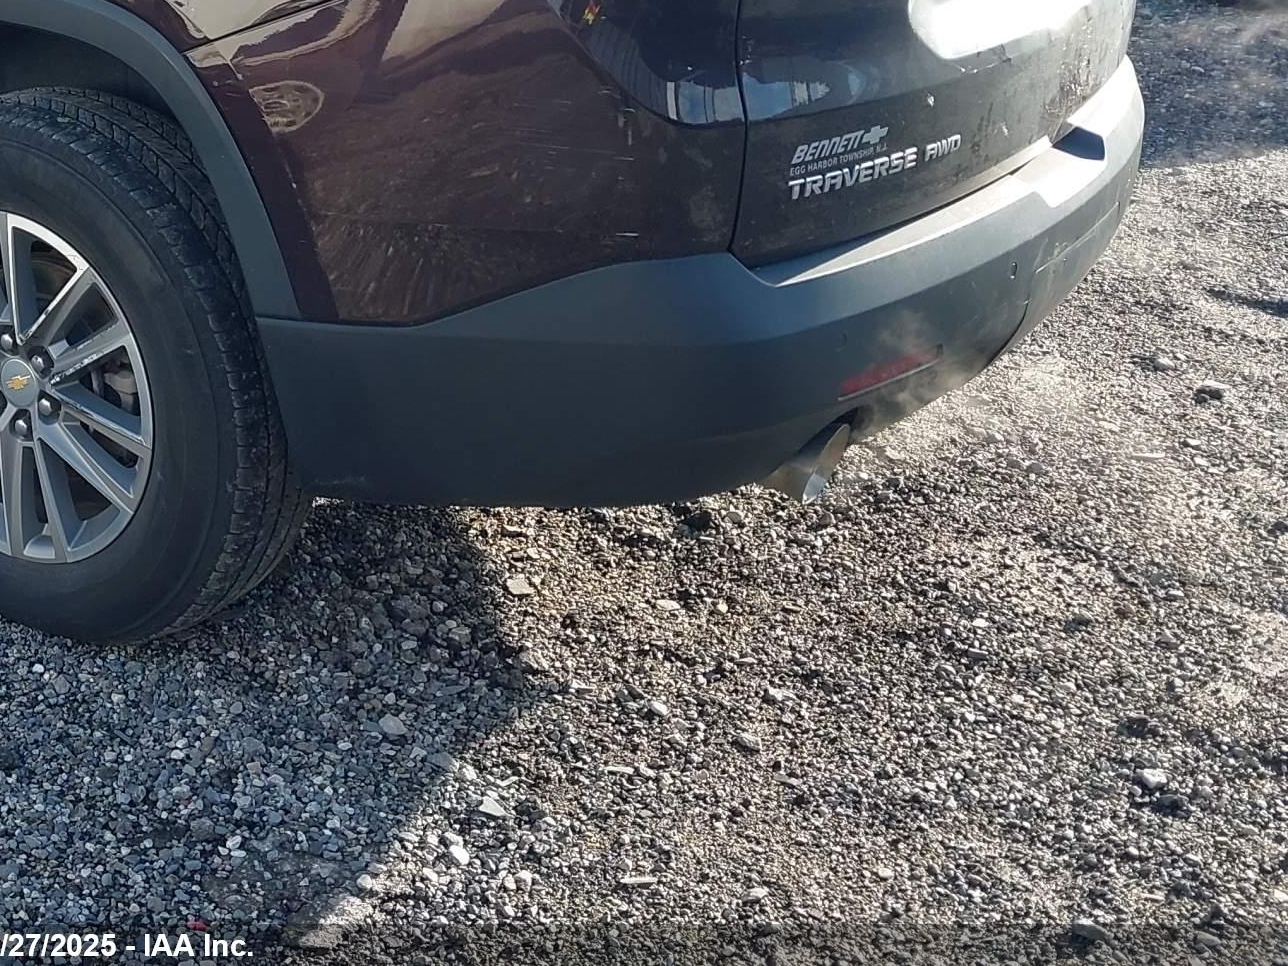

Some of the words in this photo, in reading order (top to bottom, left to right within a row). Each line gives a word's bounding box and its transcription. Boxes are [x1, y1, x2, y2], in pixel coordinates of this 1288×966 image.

[791, 130, 865, 164] BENNETT
[788, 147, 918, 200] TRAVERSE
[924, 134, 961, 161] AWD
[789, 166, 806, 177] EGG
[807, 158, 838, 172] HARBOR
